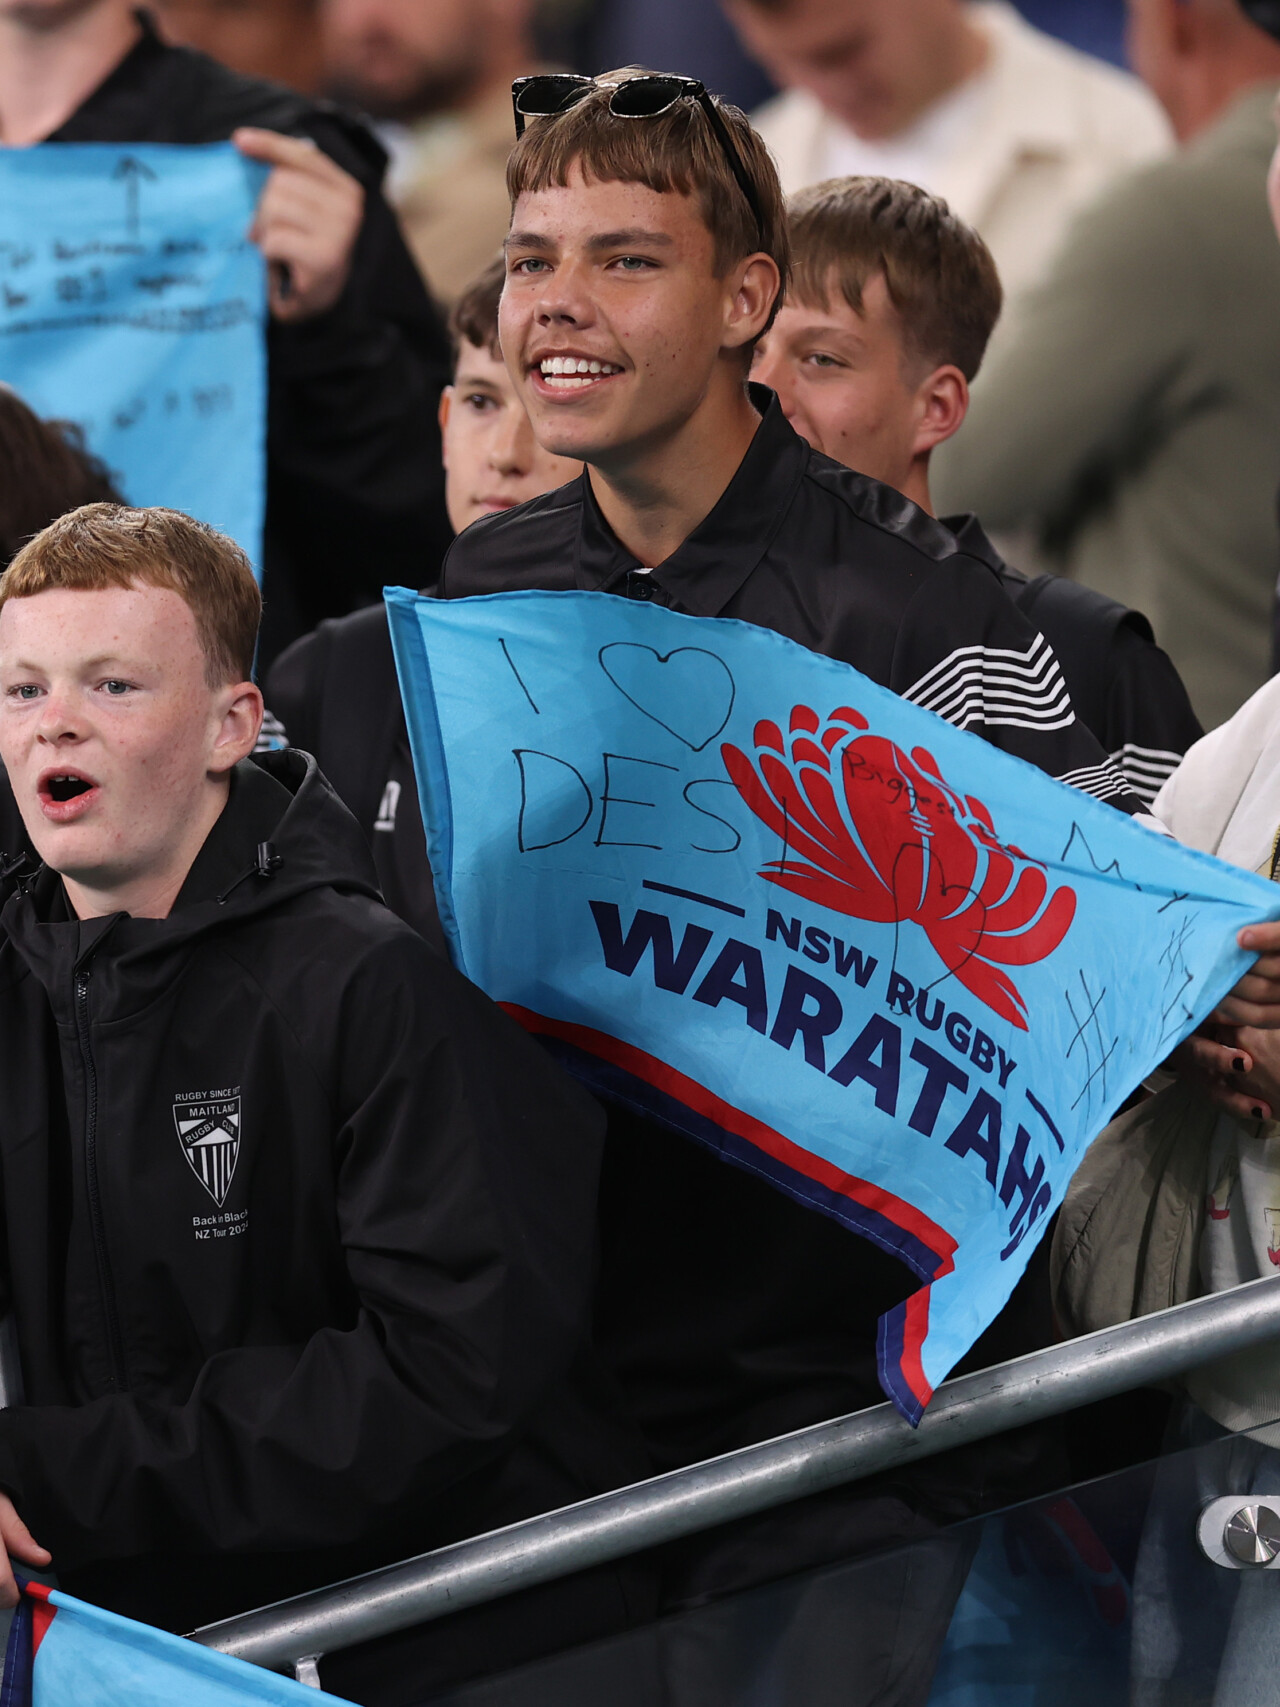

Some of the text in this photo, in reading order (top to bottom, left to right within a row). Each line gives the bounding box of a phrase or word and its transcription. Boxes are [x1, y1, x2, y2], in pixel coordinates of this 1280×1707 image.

[498, 637, 540, 715] I
[511, 748, 788, 877] DESI
[765, 908, 1018, 1090] NSW RUGBY
[588, 899, 1052, 1262] WARATAHS
[175, 1090, 208, 1101] RUGBY
[209, 1087, 232, 1098] SINCE
[189, 1103, 236, 1117] MAITLAND
[185, 1119, 235, 1143] RUGBY CLUB
[192, 1214, 218, 1226] Back
[217, 1213, 224, 1224] in
[195, 1229, 211, 1240] NZ
[212, 1228, 227, 1238] Tour
